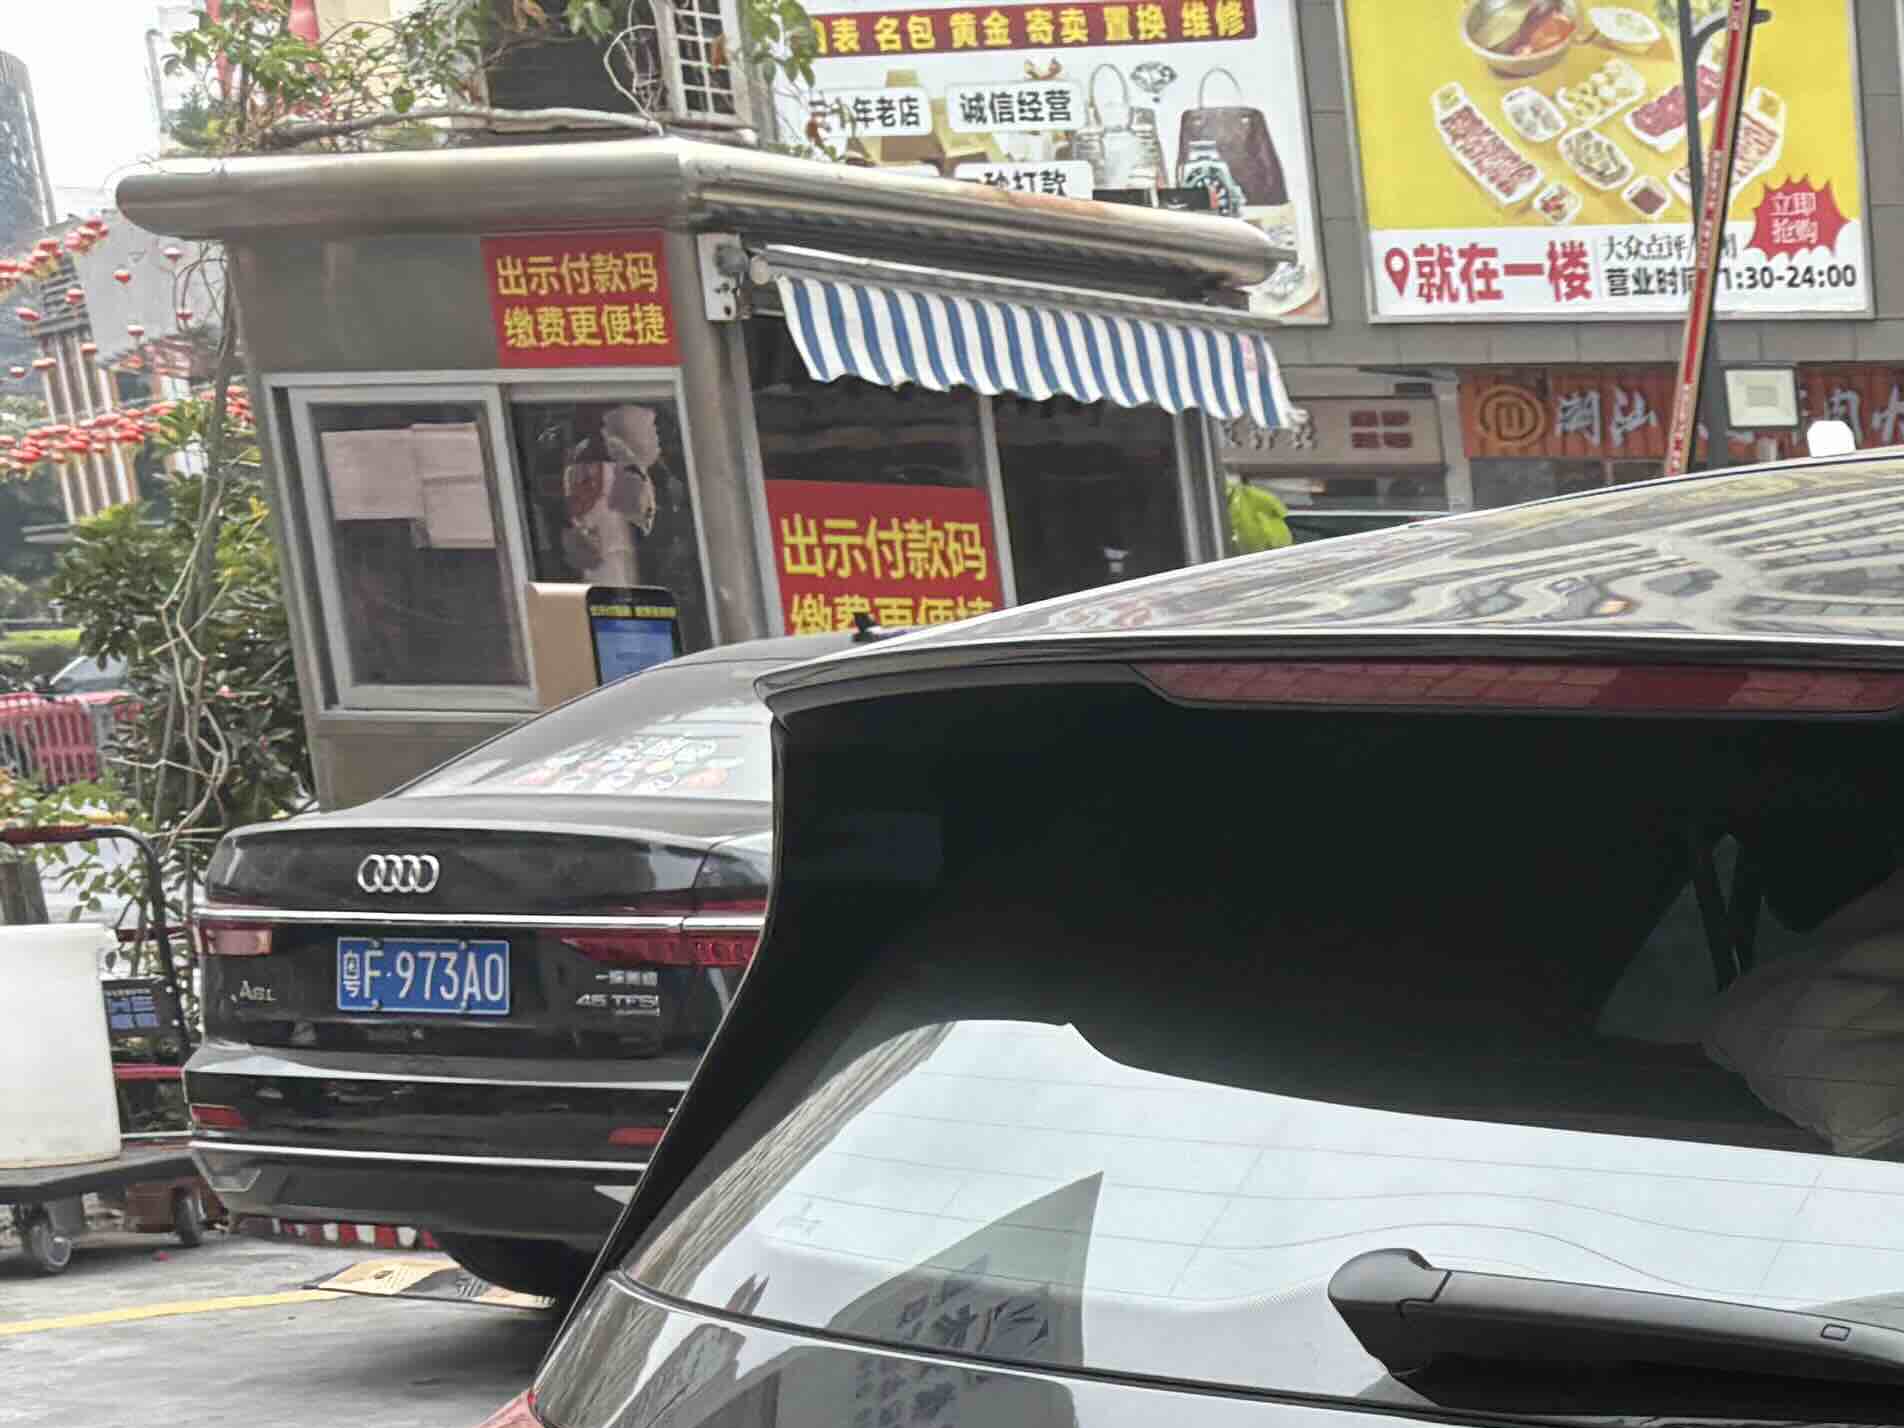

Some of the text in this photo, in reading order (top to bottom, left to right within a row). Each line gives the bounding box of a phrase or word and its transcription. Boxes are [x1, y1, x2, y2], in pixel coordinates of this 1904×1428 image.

[873, 15, 936, 51] 名包
[950, 11, 1013, 48] 黄金
[1025, 7, 1089, 44] 寄卖
[1103, 4, 1168, 41] 置换
[1180, 1, 1248, 38] 维修
[959, 89, 1072, 126] 诚信经营
[1770, 191, 1816, 215] 立即
[496, 251, 658, 296] 出示付款码
[1414, 240, 1592, 302] 就在一楼
[1717, 264, 1857, 291] 1:30-24:00
[504, 302, 670, 348] 缴费更便捷
[780, 513, 987, 581] 出示付款码
